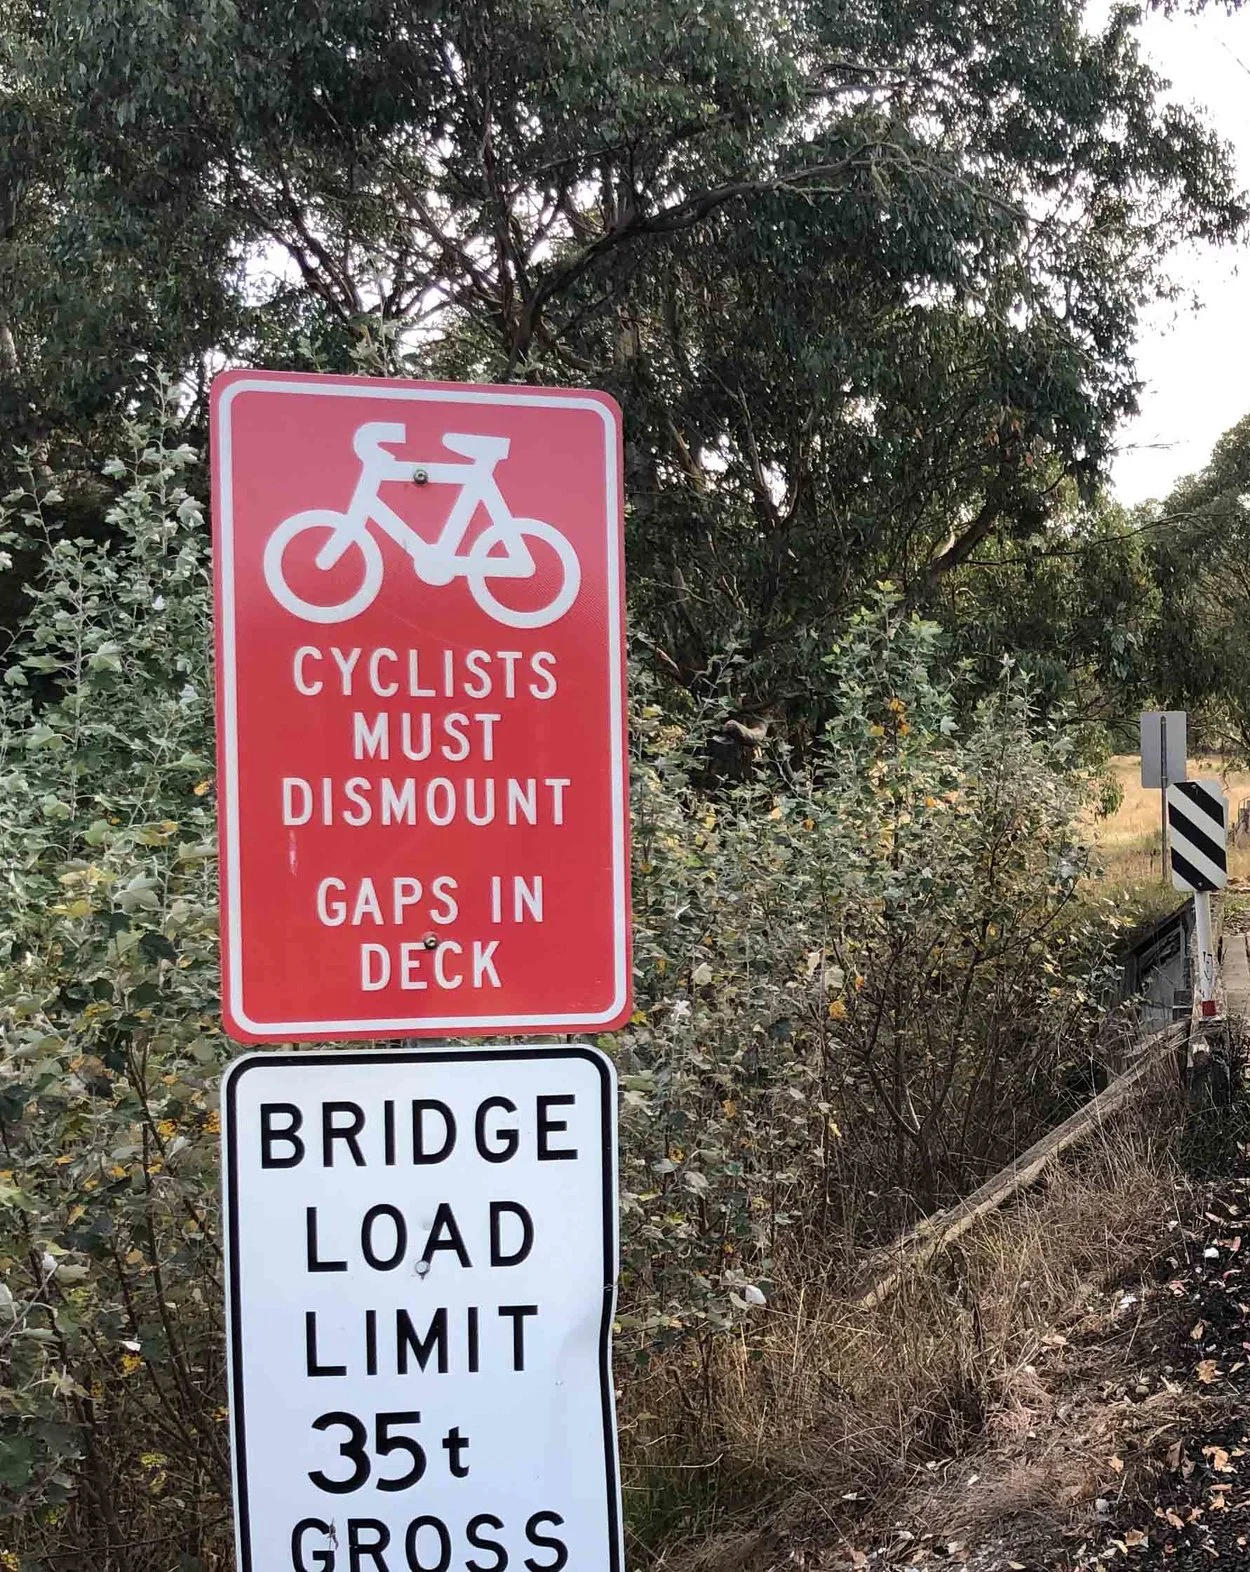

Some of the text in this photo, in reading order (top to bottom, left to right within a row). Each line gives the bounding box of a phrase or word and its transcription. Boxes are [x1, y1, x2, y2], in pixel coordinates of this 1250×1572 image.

[293, 645, 558, 700] CYCLISTS
[353, 711, 502, 762] MUST
[282, 776, 571, 827] DISMOUNT
[316, 875, 544, 927] GAPS IN
[360, 940, 502, 991] DECK
[260, 1094, 578, 1170] BRIDGE
[306, 1200, 534, 1273] LOAD
[305, 1304, 538, 1377] LIMIT
[291, 1510, 568, 1572] GROSS
